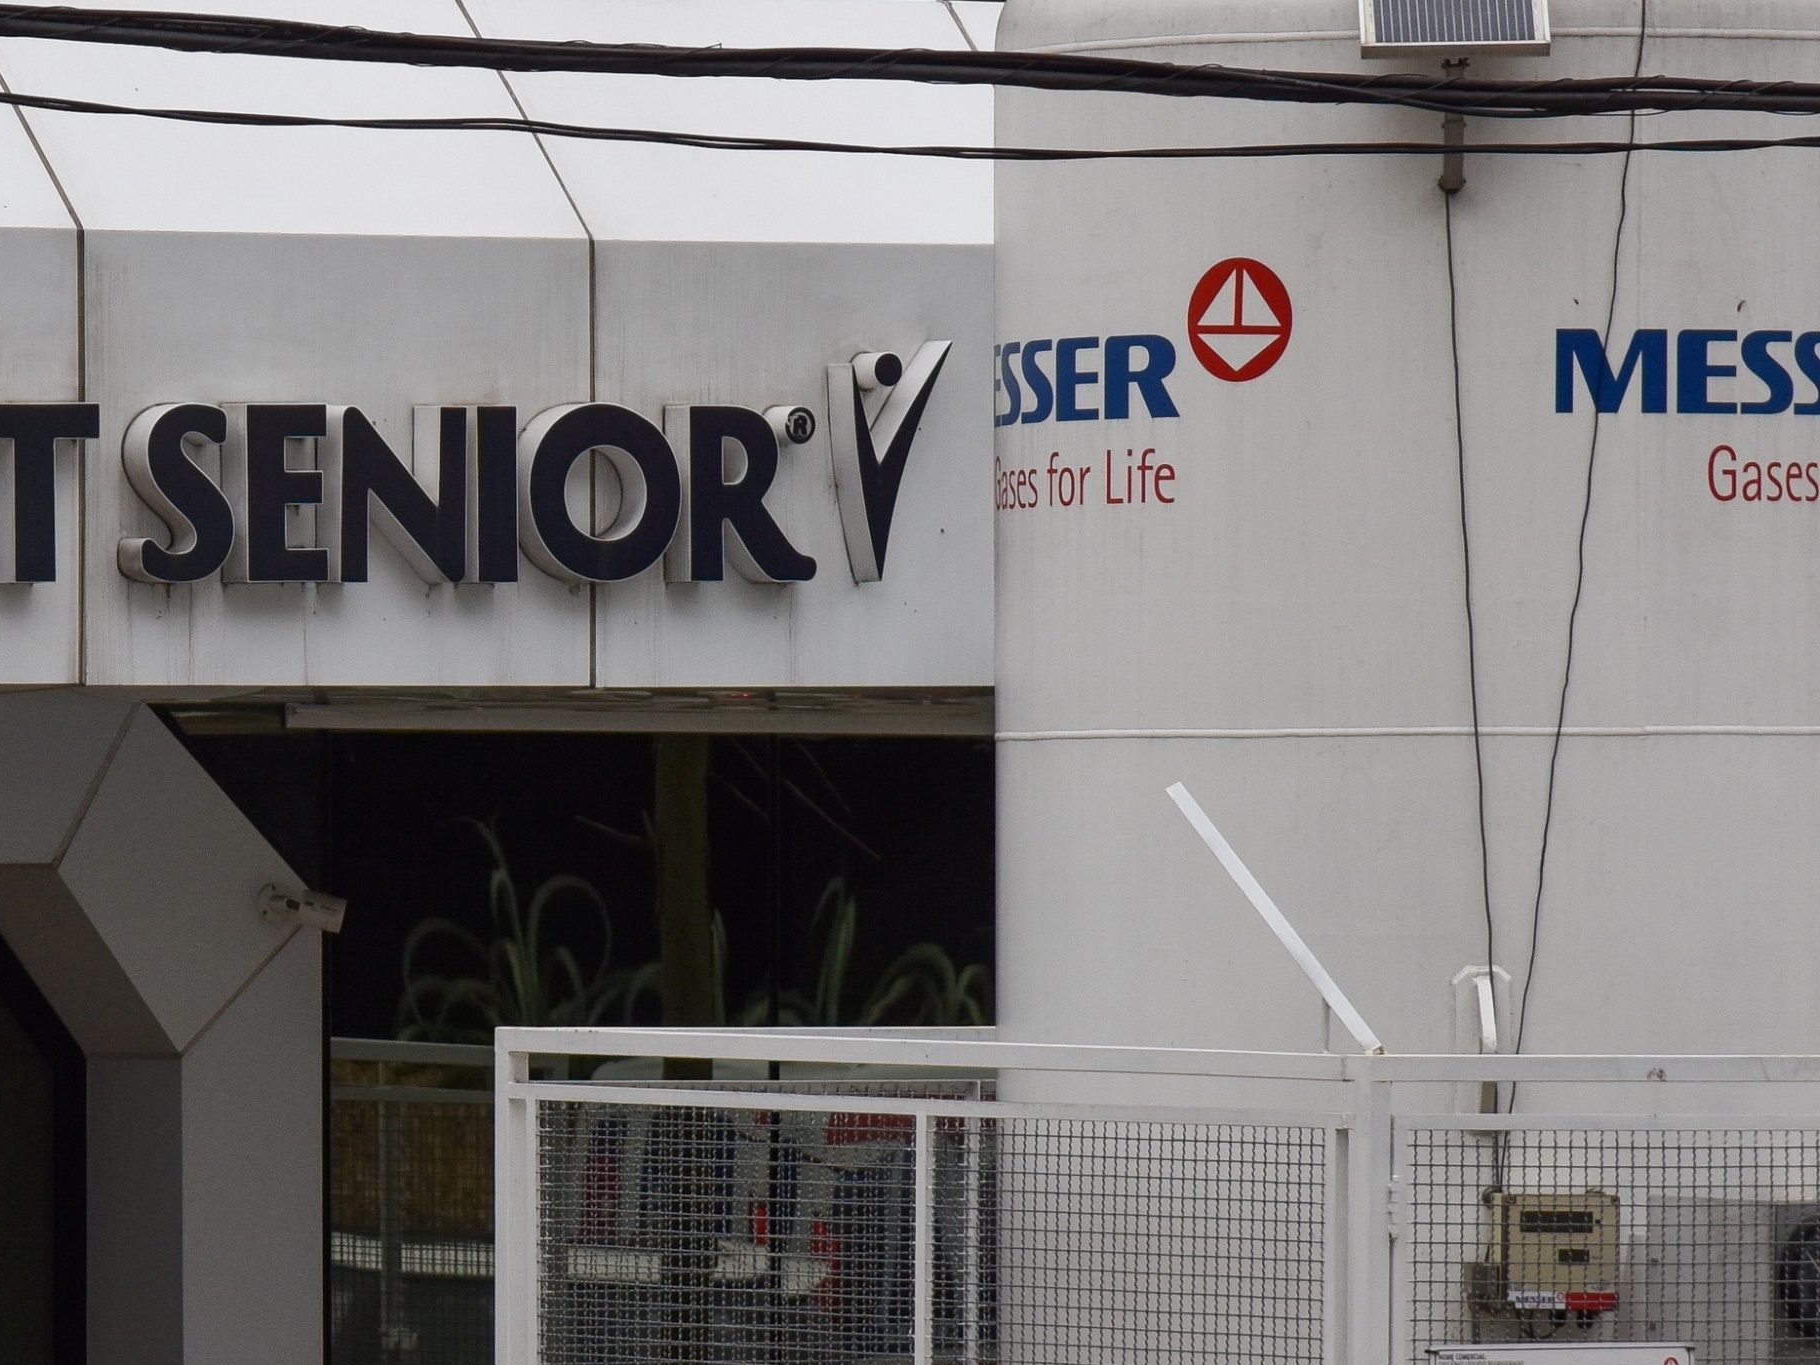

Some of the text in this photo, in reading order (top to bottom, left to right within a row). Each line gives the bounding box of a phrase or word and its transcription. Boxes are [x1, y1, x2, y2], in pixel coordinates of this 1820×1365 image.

[1046, 451, 1092, 507] for
[1105, 447, 1177, 504] Life
[1707, 444, 1820, 502] Gases
